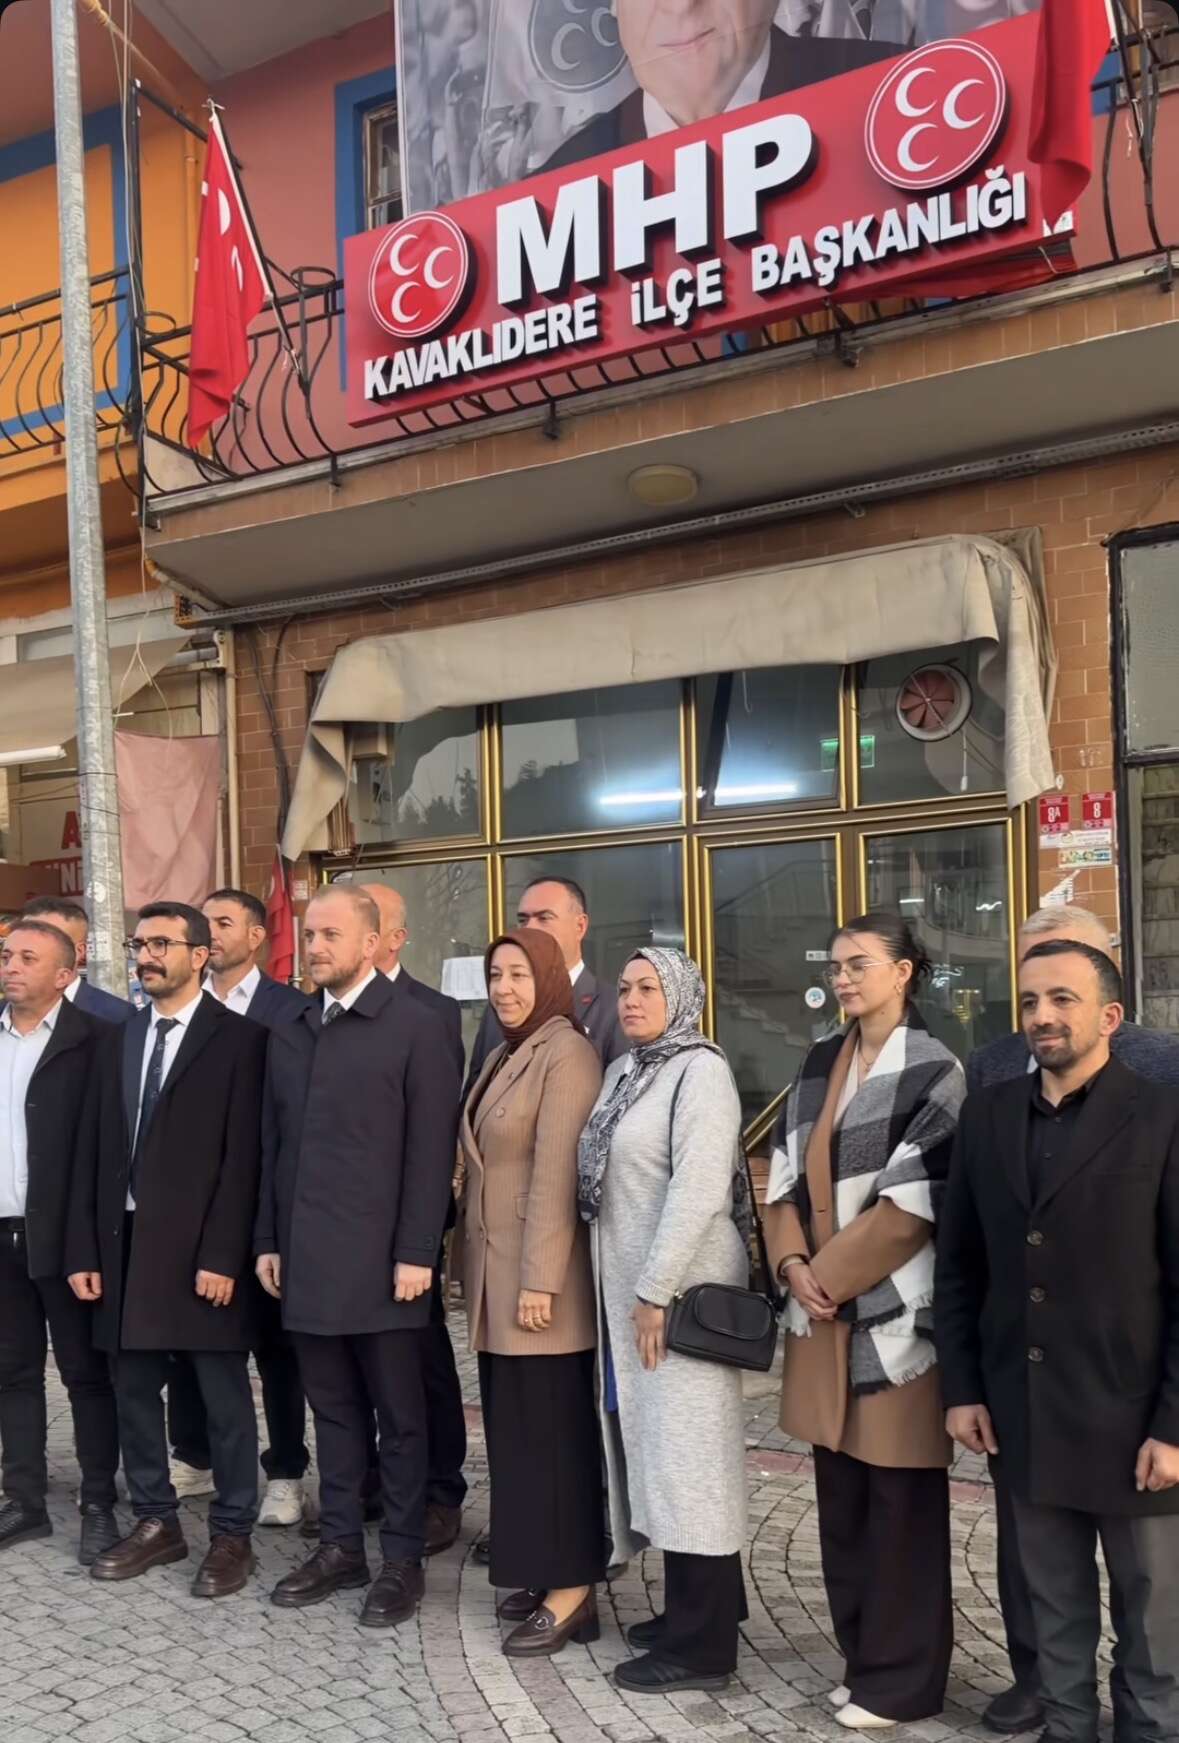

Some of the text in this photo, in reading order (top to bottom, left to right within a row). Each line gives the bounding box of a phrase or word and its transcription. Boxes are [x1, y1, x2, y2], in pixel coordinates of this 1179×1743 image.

[364, 293, 598, 400] KAVAKLIDERE
[751, 165, 1027, 287] BAŞKANLIĞI
[496, 114, 813, 305] MHP
[1093, 802, 1102, 819] 8
